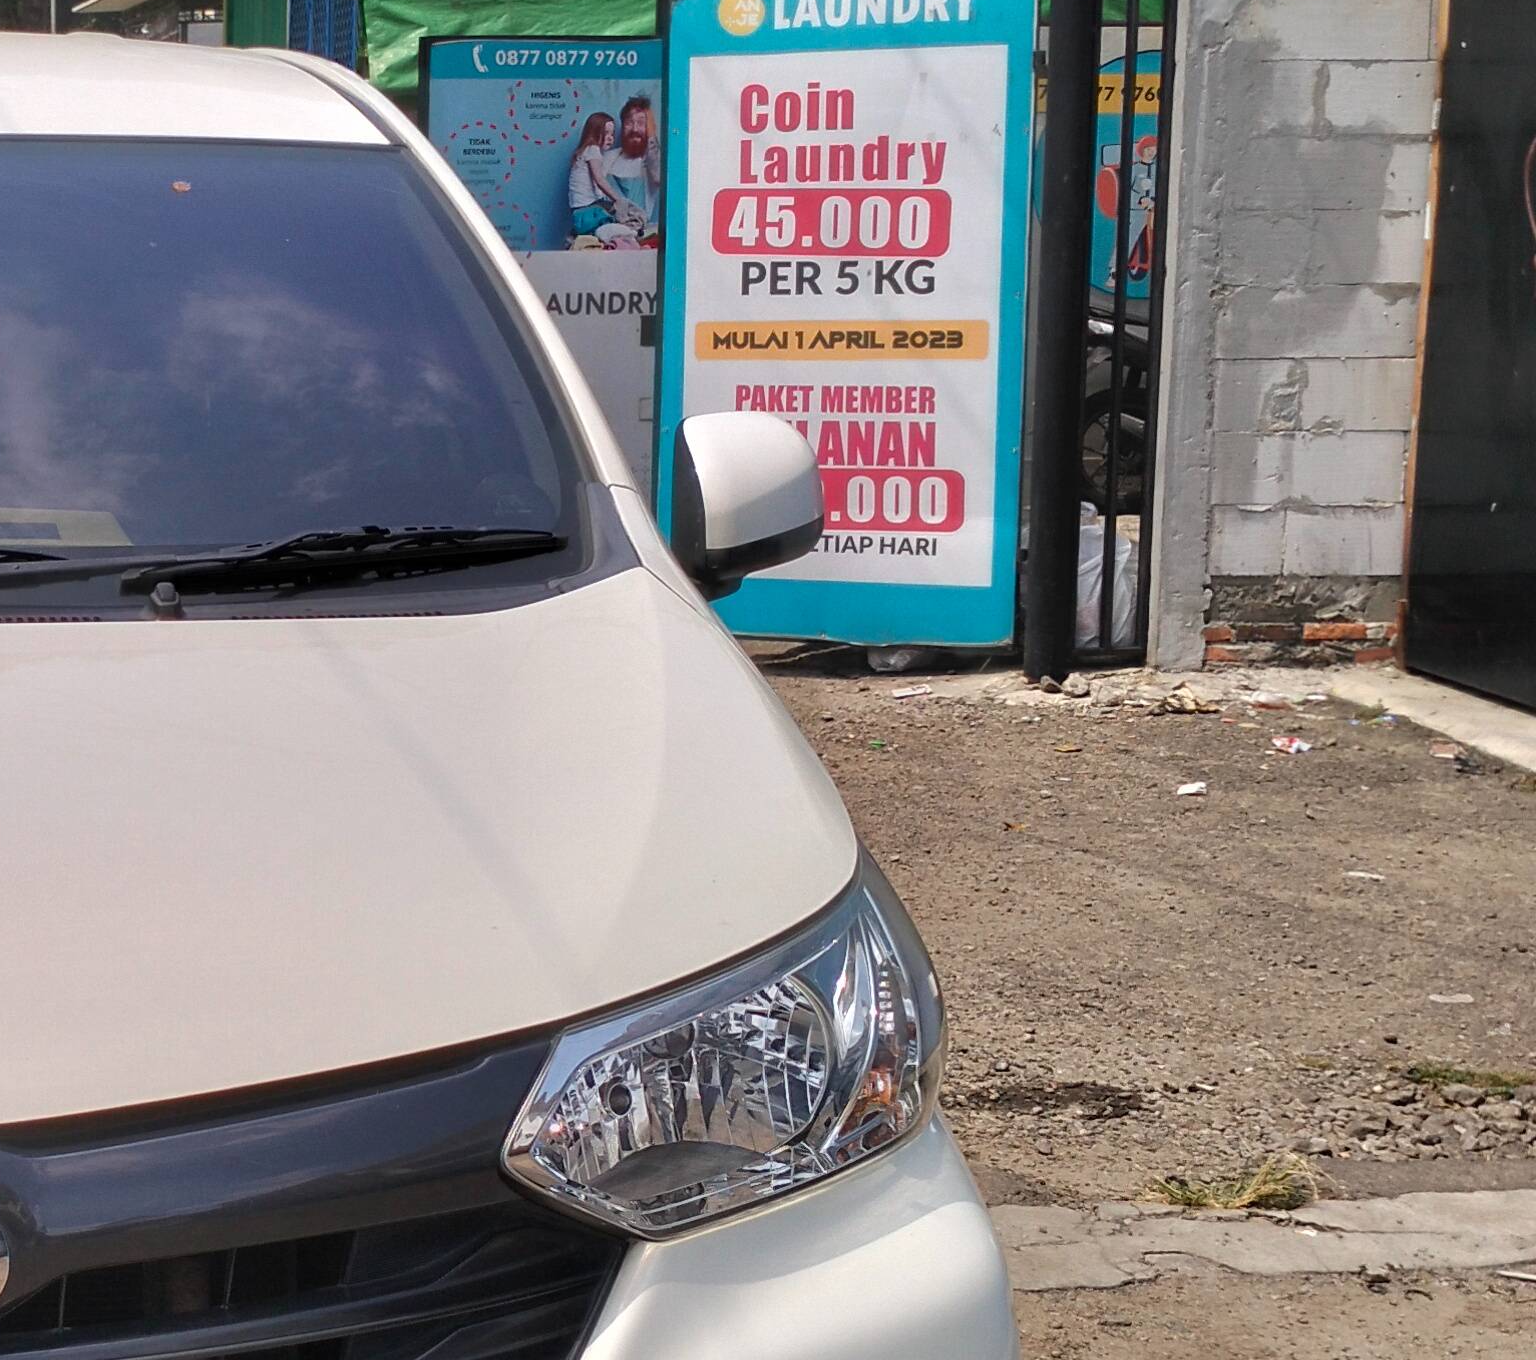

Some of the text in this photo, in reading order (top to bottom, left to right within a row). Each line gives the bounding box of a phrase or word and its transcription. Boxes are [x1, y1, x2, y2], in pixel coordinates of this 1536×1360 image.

[495, 50, 638, 67] 0877 0877 9760
[739, 81, 855, 135] Coin
[739, 135, 947, 185] Laundry
[728, 195, 932, 249] 45.000
[740, 259, 935, 296] PER 5 KG
[546, 291, 657, 316] AUNDRY
[712, 330, 964, 350] MULAI 1 APRIL 2023
[735, 384, 936, 414] PAKET MEMBER
[879, 536, 937, 556] HARI
